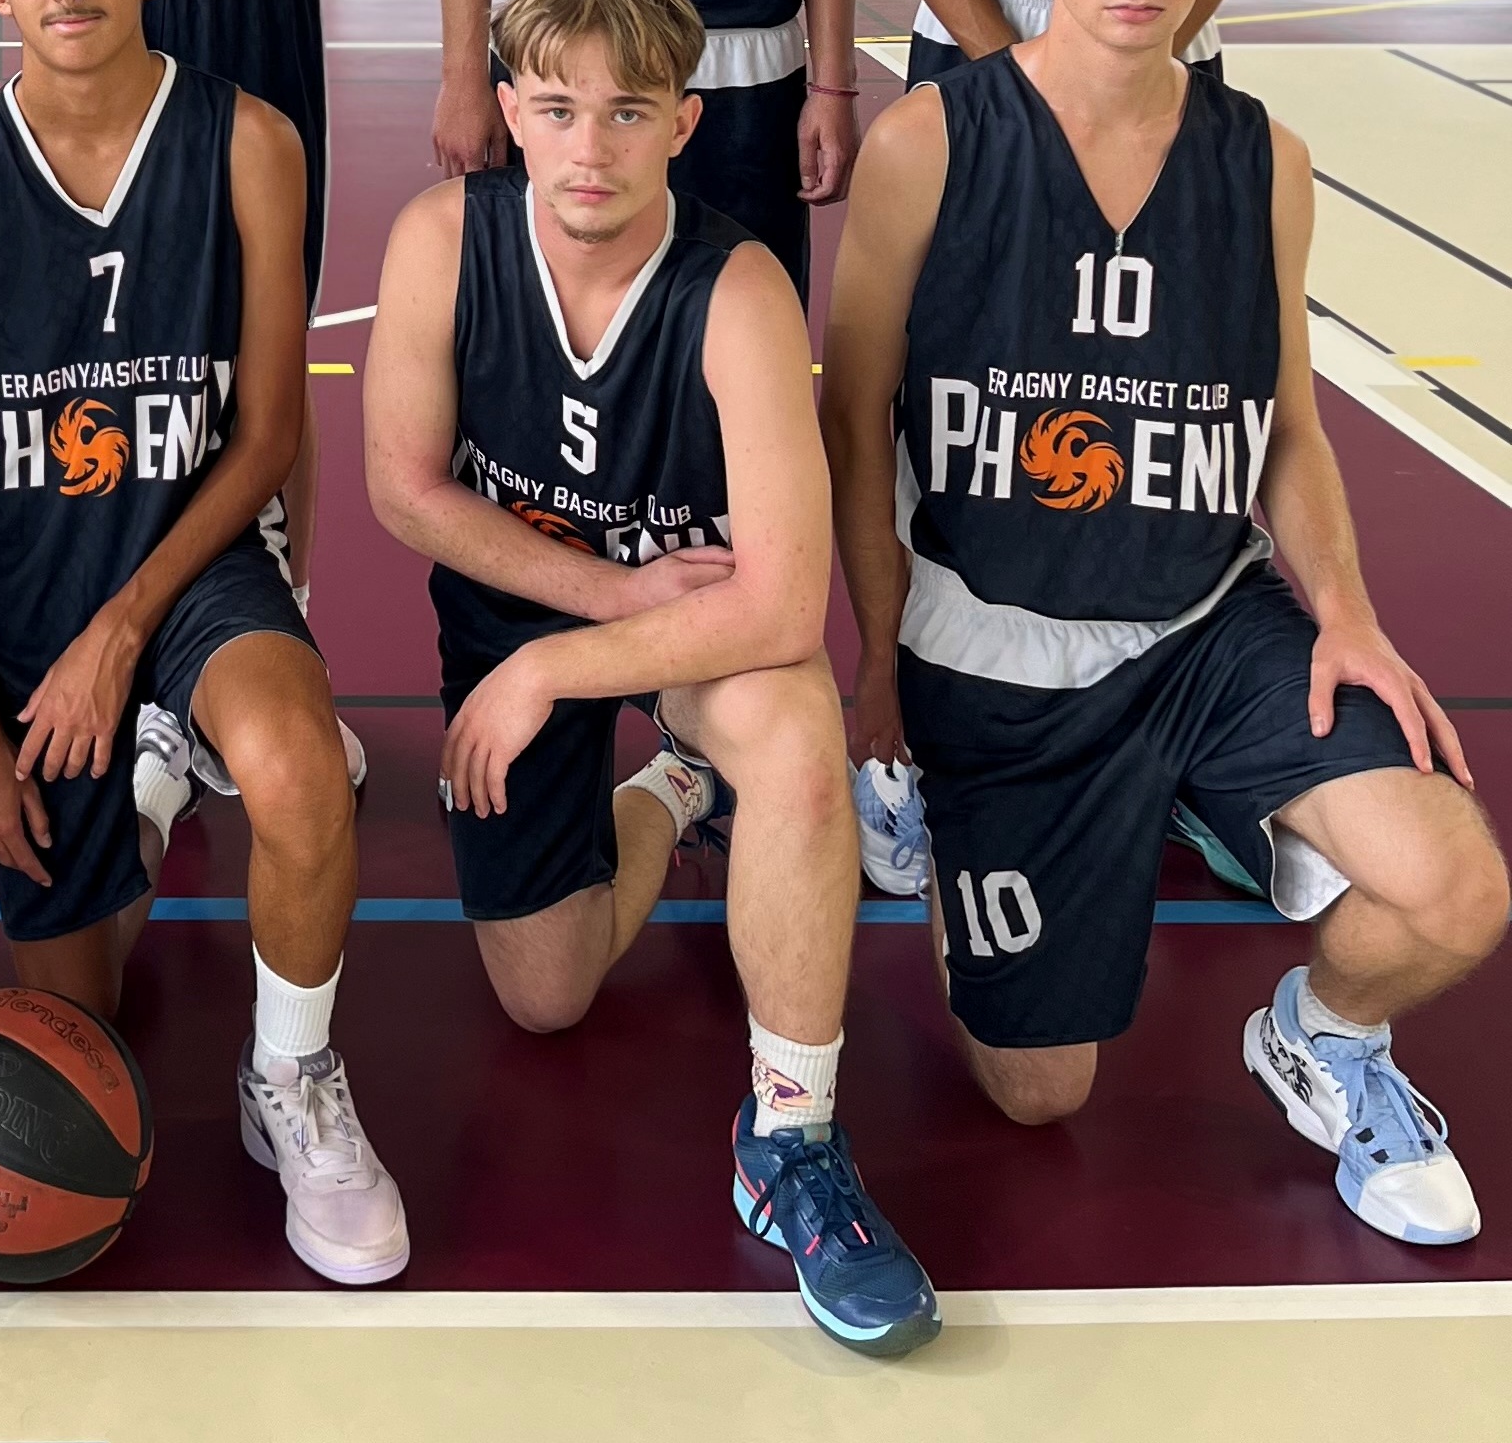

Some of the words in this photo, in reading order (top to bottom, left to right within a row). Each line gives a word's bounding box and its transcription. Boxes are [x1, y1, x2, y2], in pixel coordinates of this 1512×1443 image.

[89, 251, 125, 332] 7
[1072, 253, 1153, 338] 10
[1, 363, 90, 399] ERAGNY
[91, 356, 171, 388] BASKET
[177, 354, 209, 382] CLU
[988, 367, 1072, 399] ERAGNY
[1081, 374, 1178, 408] BASKET
[561, 394, 598, 475] 5
[467, 437, 544, 501] ERAGNY
[554, 486, 640, 522] BASKET
[957, 870, 1042, 957] 10
